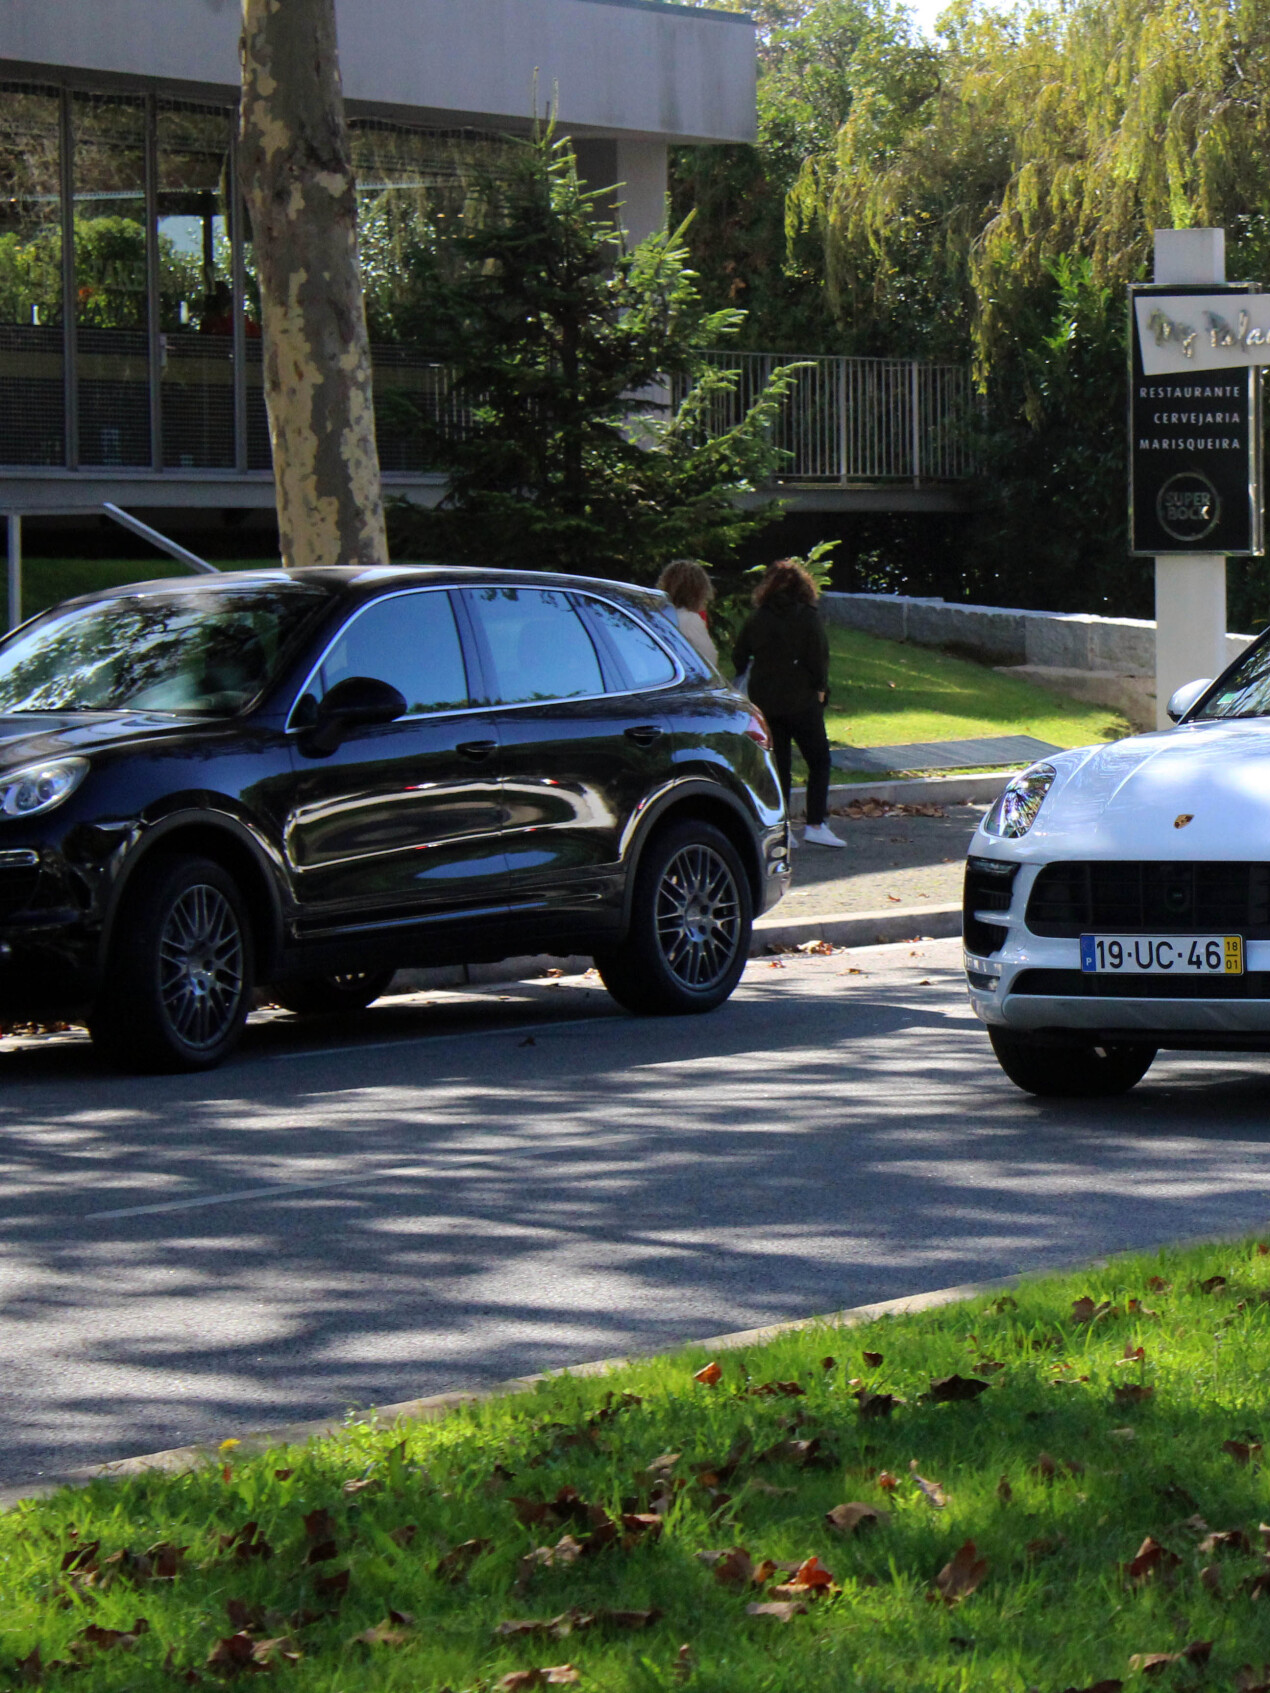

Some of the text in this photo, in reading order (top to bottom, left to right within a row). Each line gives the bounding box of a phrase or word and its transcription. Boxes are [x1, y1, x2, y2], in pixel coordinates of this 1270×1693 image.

[1139, 386, 1240, 398] RESTAURANTE
[1153, 412, 1240, 426] CERVEJARIA
[1139, 438, 1240, 451] MARISQUEIRA
[1165, 492, 1210, 506] SUPER
[1167, 506, 1210, 520] BOCK
[1226, 941, 1238, 952] 18
[1226, 959, 1238, 970] 01
